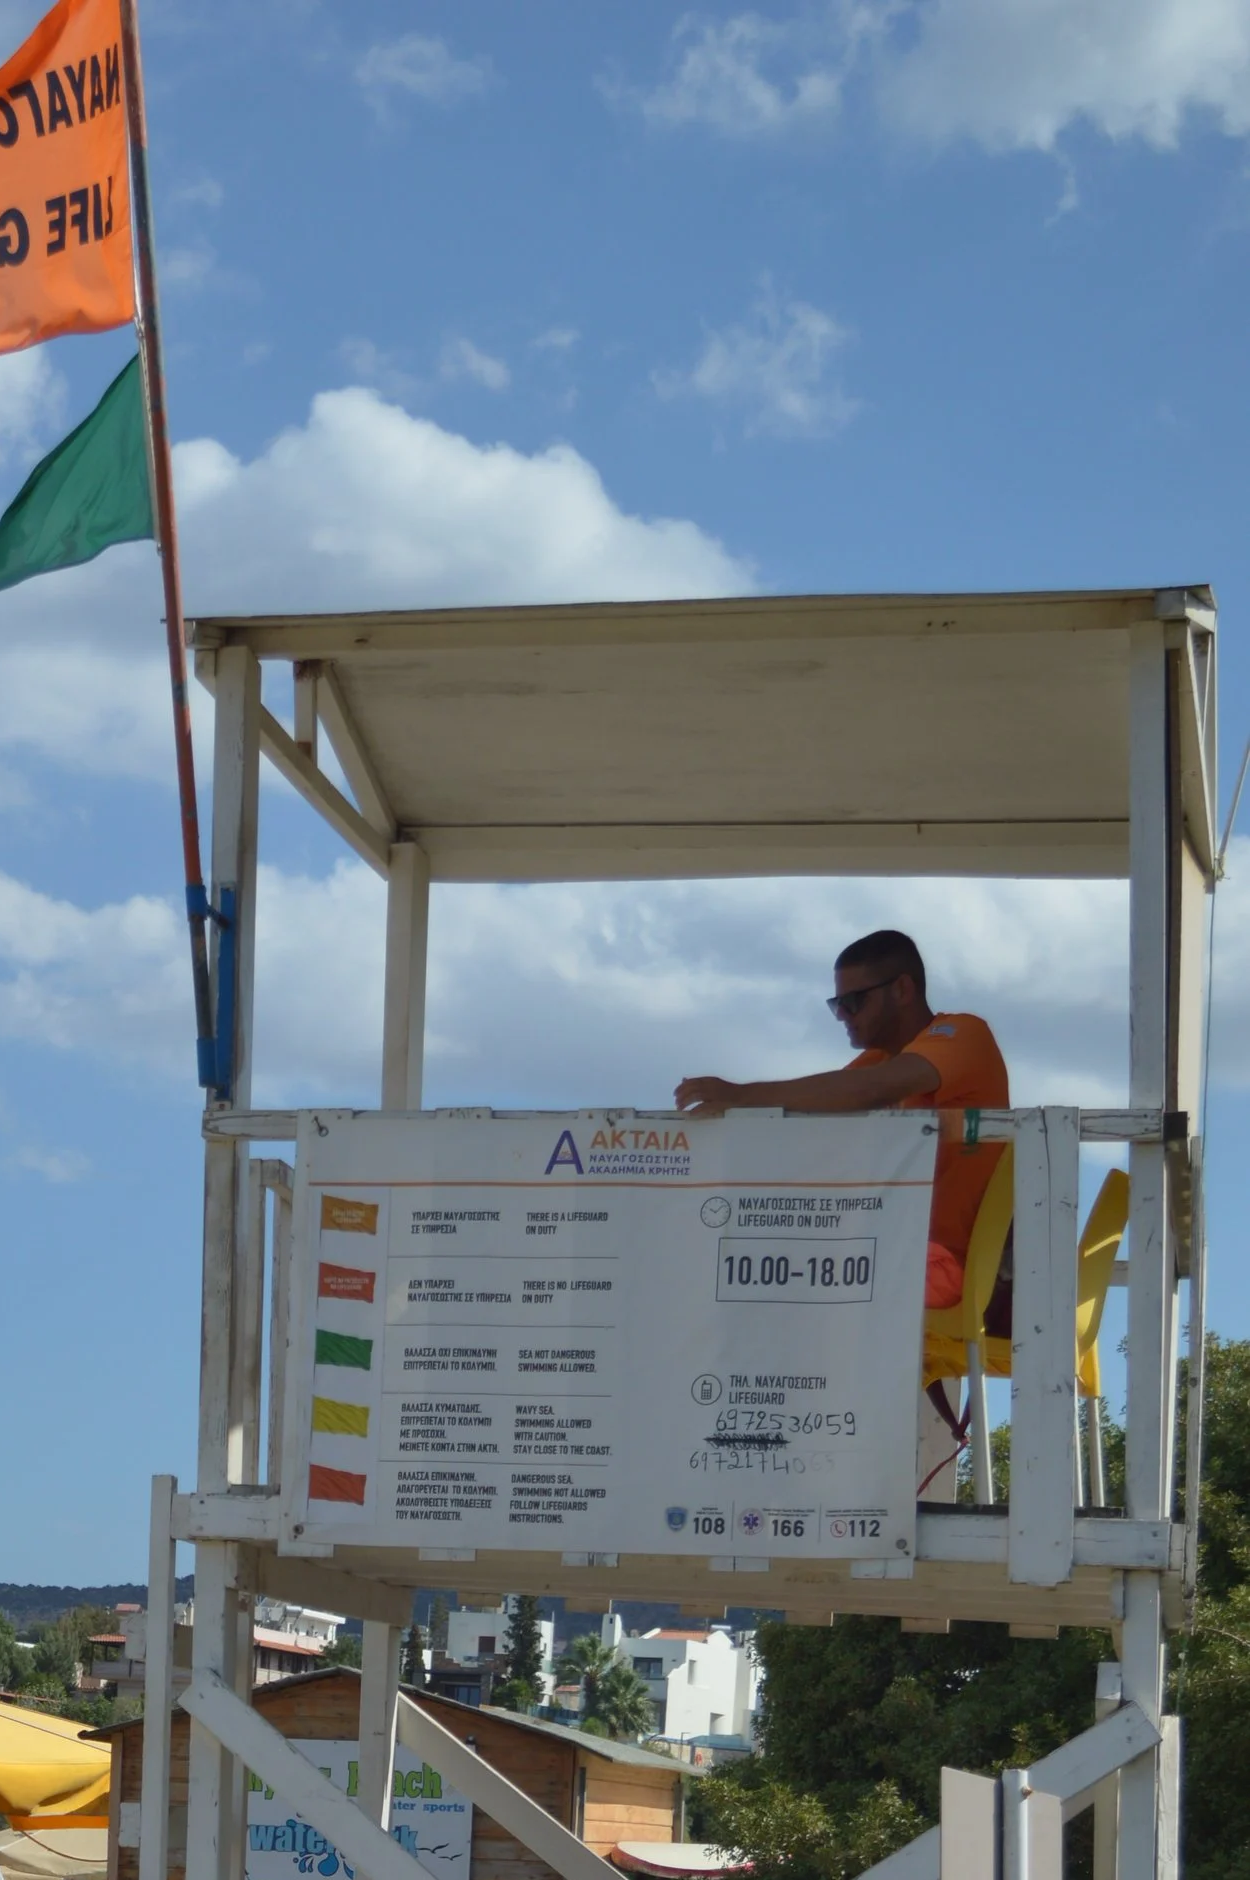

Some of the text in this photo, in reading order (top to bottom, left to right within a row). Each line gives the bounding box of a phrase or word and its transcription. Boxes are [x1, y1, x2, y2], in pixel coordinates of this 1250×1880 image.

[590, 1130, 691, 1152] ΑΚΤΑΙΑ
[588, 1153, 691, 1164] ΝΑΥΑΓΟΣΩΣΤΙΚΗ
[588, 1165, 691, 1176] ΑΚΑΔΗΜΙΑ ΚΡΗΤΗΣ
[738, 1197, 883, 1211] ΝΑΥΑΓΟΣΩΣΤΗΣ ΣΕ ΥΠΗΡΕΣΙΑ
[411, 1211, 501, 1222] ΥΠΑΡΧΕΙ ΝΑΥΑΓΟΣΩΣΤΗΣ
[526, 1212, 609, 1222] THERE IS A LIFEGUARD
[737, 1214, 841, 1228] LIFEGUARD ON DUTY
[410, 1225, 457, 1234] ΣΕ ΥΠΗΡΕΣΙΑ
[525, 1225, 557, 1235] ON DUTY
[408, 1279, 455, 1290] ΔΕΝ ΥΠΑΡΧΕΙ
[523, 1281, 612, 1291] THERE IS NO LIFEGUARD
[407, 1292, 512, 1304] ΝΑΥΑΓΟΣΩΣΤΗΣ ΣΕ ΥΠΗΡΕΣΙΑ
[521, 1294, 553, 1304] ON DUTY
[404, 1347, 497, 1358] ΘΑΛΑΣΣΑ ΟΧΙ ΕΠΙΚΙΝΔΥΝΗ
[518, 1349, 596, 1360] SEA NOT DANGEROUS
[403, 1361, 449, 1371] ΕΠΙΤΡΕΠΕΤΑΙ
[450, 1361, 460, 1371] ΤΟ
[518, 1363, 557, 1373] SWIMMING
[729, 1374, 827, 1390] ΤΗΛ. ΝΑΥΑΓΟΣΩΣΤΗ
[728, 1391, 785, 1405] LIFEGUARD
[401, 1403, 434, 1413] ΘΑΛΑΣΣΑ
[515, 1405, 538, 1415] WAVY
[400, 1416, 492, 1427] ΕΠΙΤΡΕΠΕΤΑΙ ΤΟ ΚΟΛΥΜΠΙ
[514, 1419, 592, 1429] SWIMMING ALLOWED
[715, 1408, 856, 1436] 6972536059
[400, 1429, 410, 1439] ΜΕ
[514, 1432, 534, 1441] WITH
[399, 1442, 430, 1452] ΜΕΙΝΕΤΕ
[430, 1442, 455, 1452] ΚΟΝΤΑ
[456, 1443, 476, 1453] ΣΤΗΝ
[513, 1444, 533, 1454] STAY
[533, 1445, 558, 1455] CLOSE
[558, 1445, 569, 1455] TO
[569, 1445, 584, 1455] THE
[397, 1471, 430, 1481] ΘΑΛΑΣΣΑ
[511, 1474, 556, 1484] DANGEROUS
[396, 1484, 448, 1495] ΑΠΑΓΟΡΕΥΕΤΑΙ
[452, 1485, 462, 1495] ΤΟ
[512, 1487, 606, 1499] SWIMMING NOT ALLOWED
[449, 1499, 492, 1508] ΥΠΟΔΕΙΞΕΙΣ
[509, 1501, 588, 1511] FOLLOW LIFEGUARDS
[395, 1511, 409, 1520] ΤΟΥ
[693, 1516, 726, 1535] 108
[771, 1519, 805, 1538] 166
[848, 1519, 881, 1538] 112
[422, 1802, 466, 1814] sports
